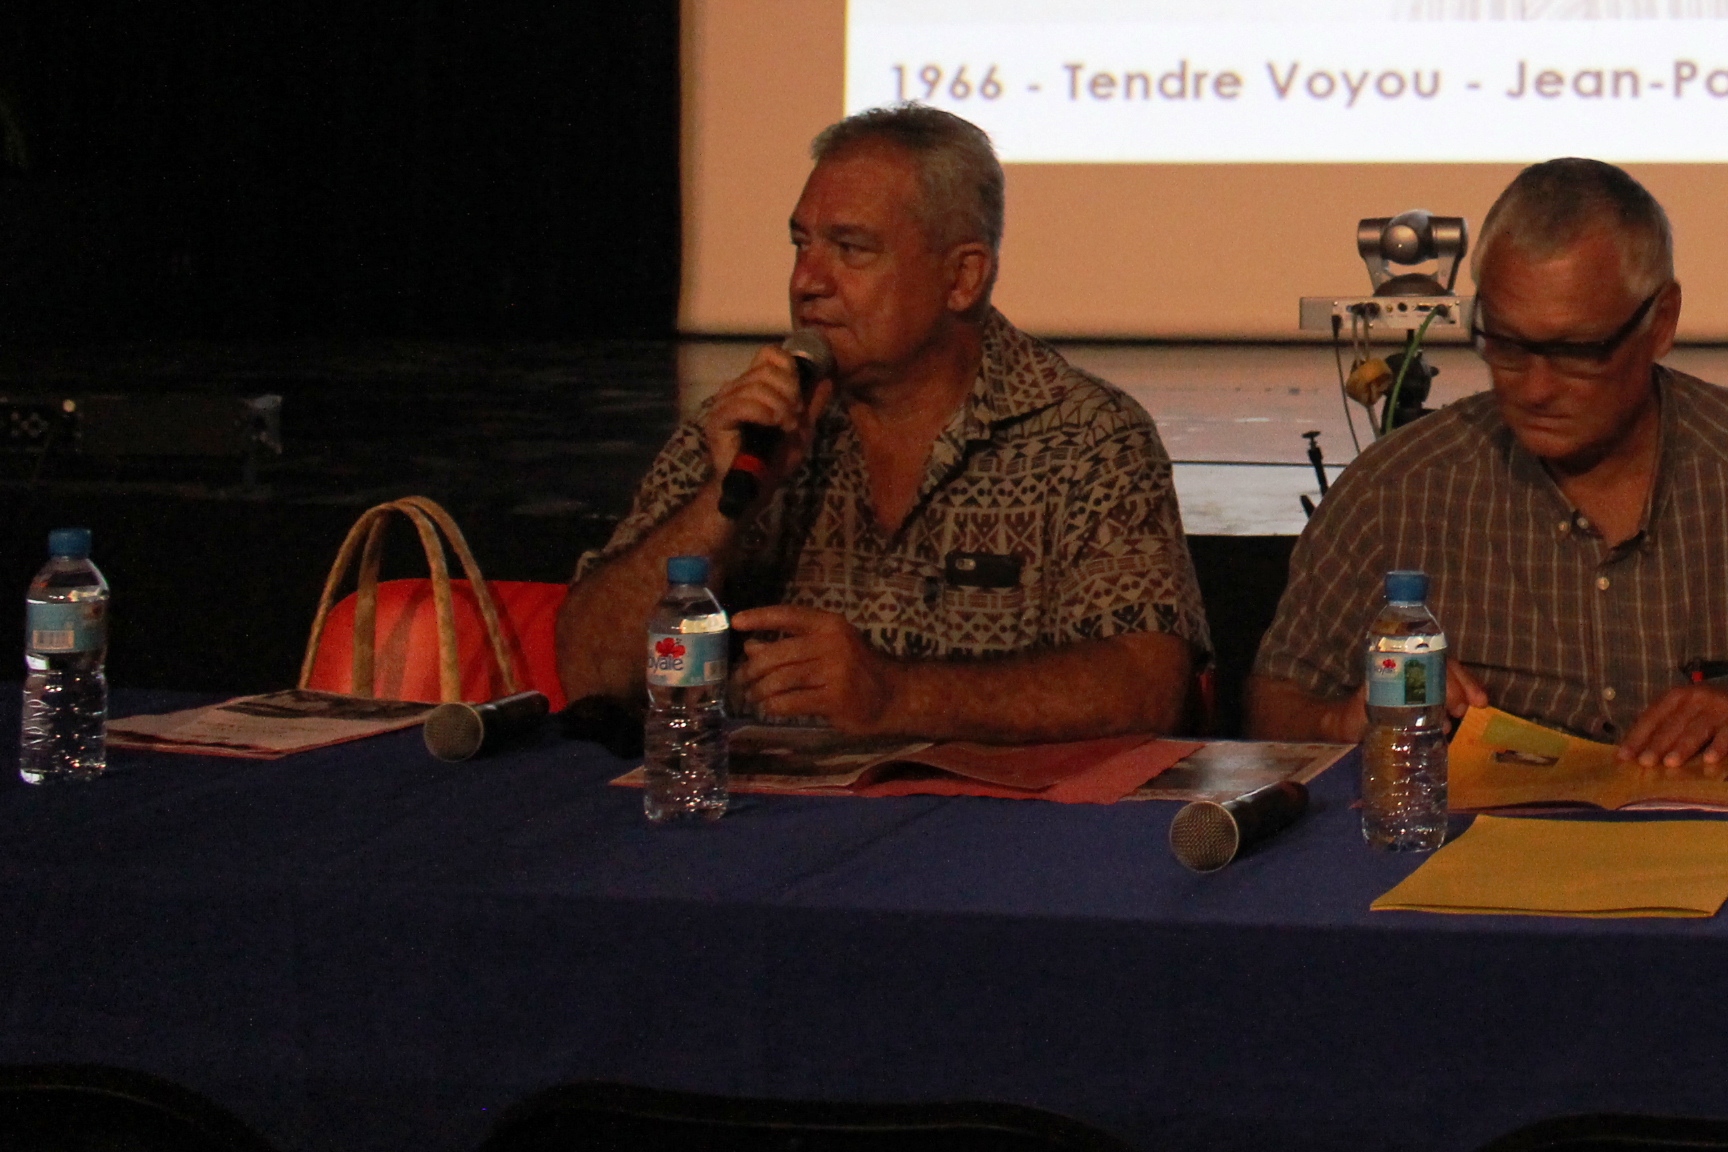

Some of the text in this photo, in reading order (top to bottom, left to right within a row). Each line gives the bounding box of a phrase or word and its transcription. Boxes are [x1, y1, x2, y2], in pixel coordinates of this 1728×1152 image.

[893, 63, 1004, 102] 1966
[1062, 59, 1243, 101] Tendre
[1266, 61, 1441, 108] Voyou
[647, 654, 684, 674] oyale
